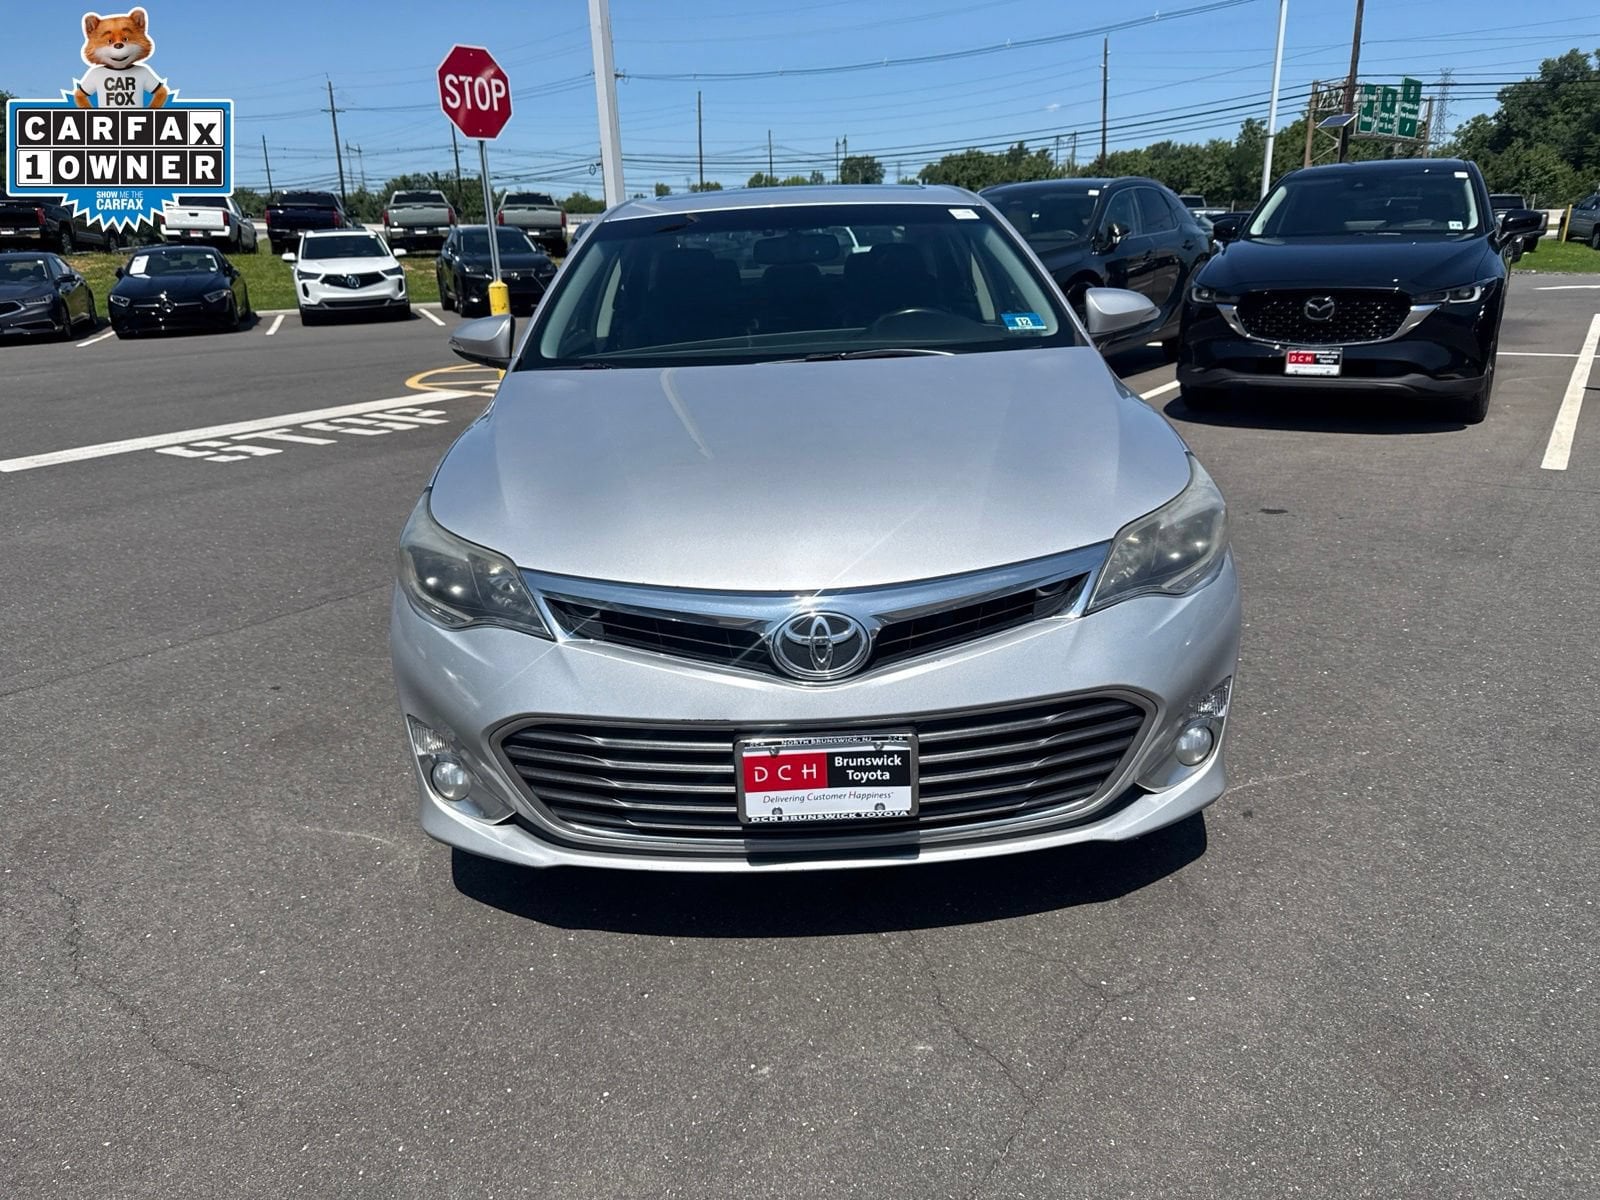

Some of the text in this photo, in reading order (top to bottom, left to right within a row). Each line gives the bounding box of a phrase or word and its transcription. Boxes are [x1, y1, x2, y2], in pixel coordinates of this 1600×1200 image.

[444, 73, 506, 111] STOP
[834, 754, 902, 767] Brunswick
[846, 769, 891, 783] Toyota
[762, 791, 892, 804] Delivering Customer Happiness
[751, 810, 908, 823] DCH BRUNSWICK TOYOTA
